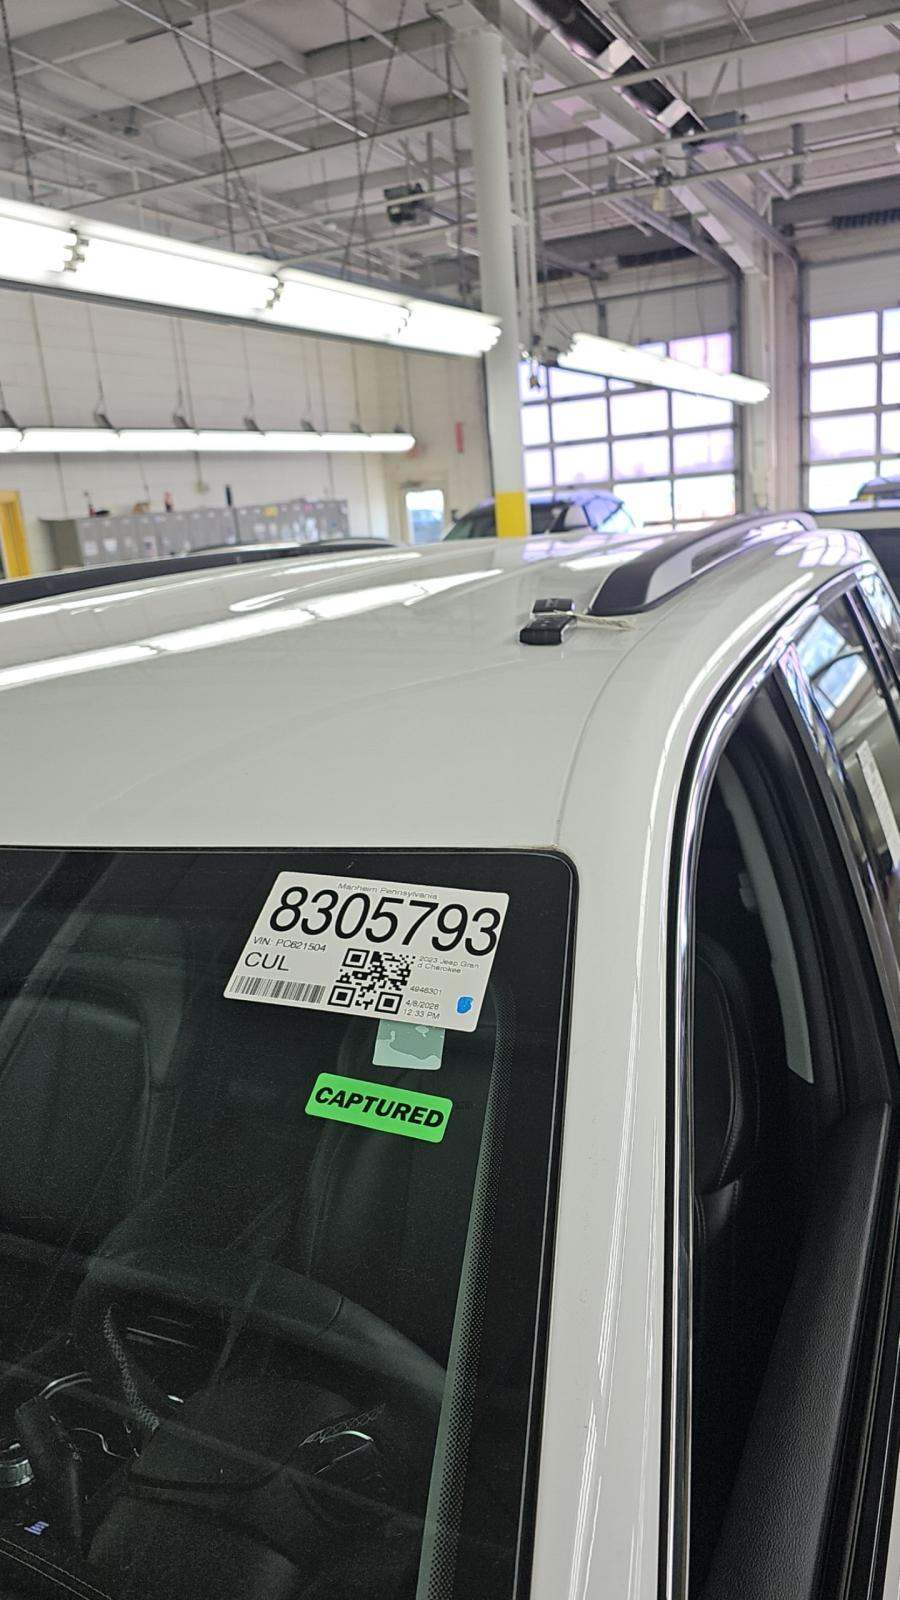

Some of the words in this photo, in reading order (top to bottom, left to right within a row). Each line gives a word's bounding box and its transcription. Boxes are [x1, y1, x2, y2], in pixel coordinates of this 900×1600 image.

[380, 887, 438, 900] Pennsylvania
[270, 886, 501, 957] 8305793
[252, 936, 272, 946] VIN:
[276, 939, 327, 953] PC621504
[244, 952, 289, 972] CUL
[425, 963, 461, 974] Cherokee
[440, 959, 459, 967] Jeep
[460, 960, 480, 969] Gran
[427, 1011, 440, 1020] PM
[315, 1087, 445, 1128] CAPTURED
